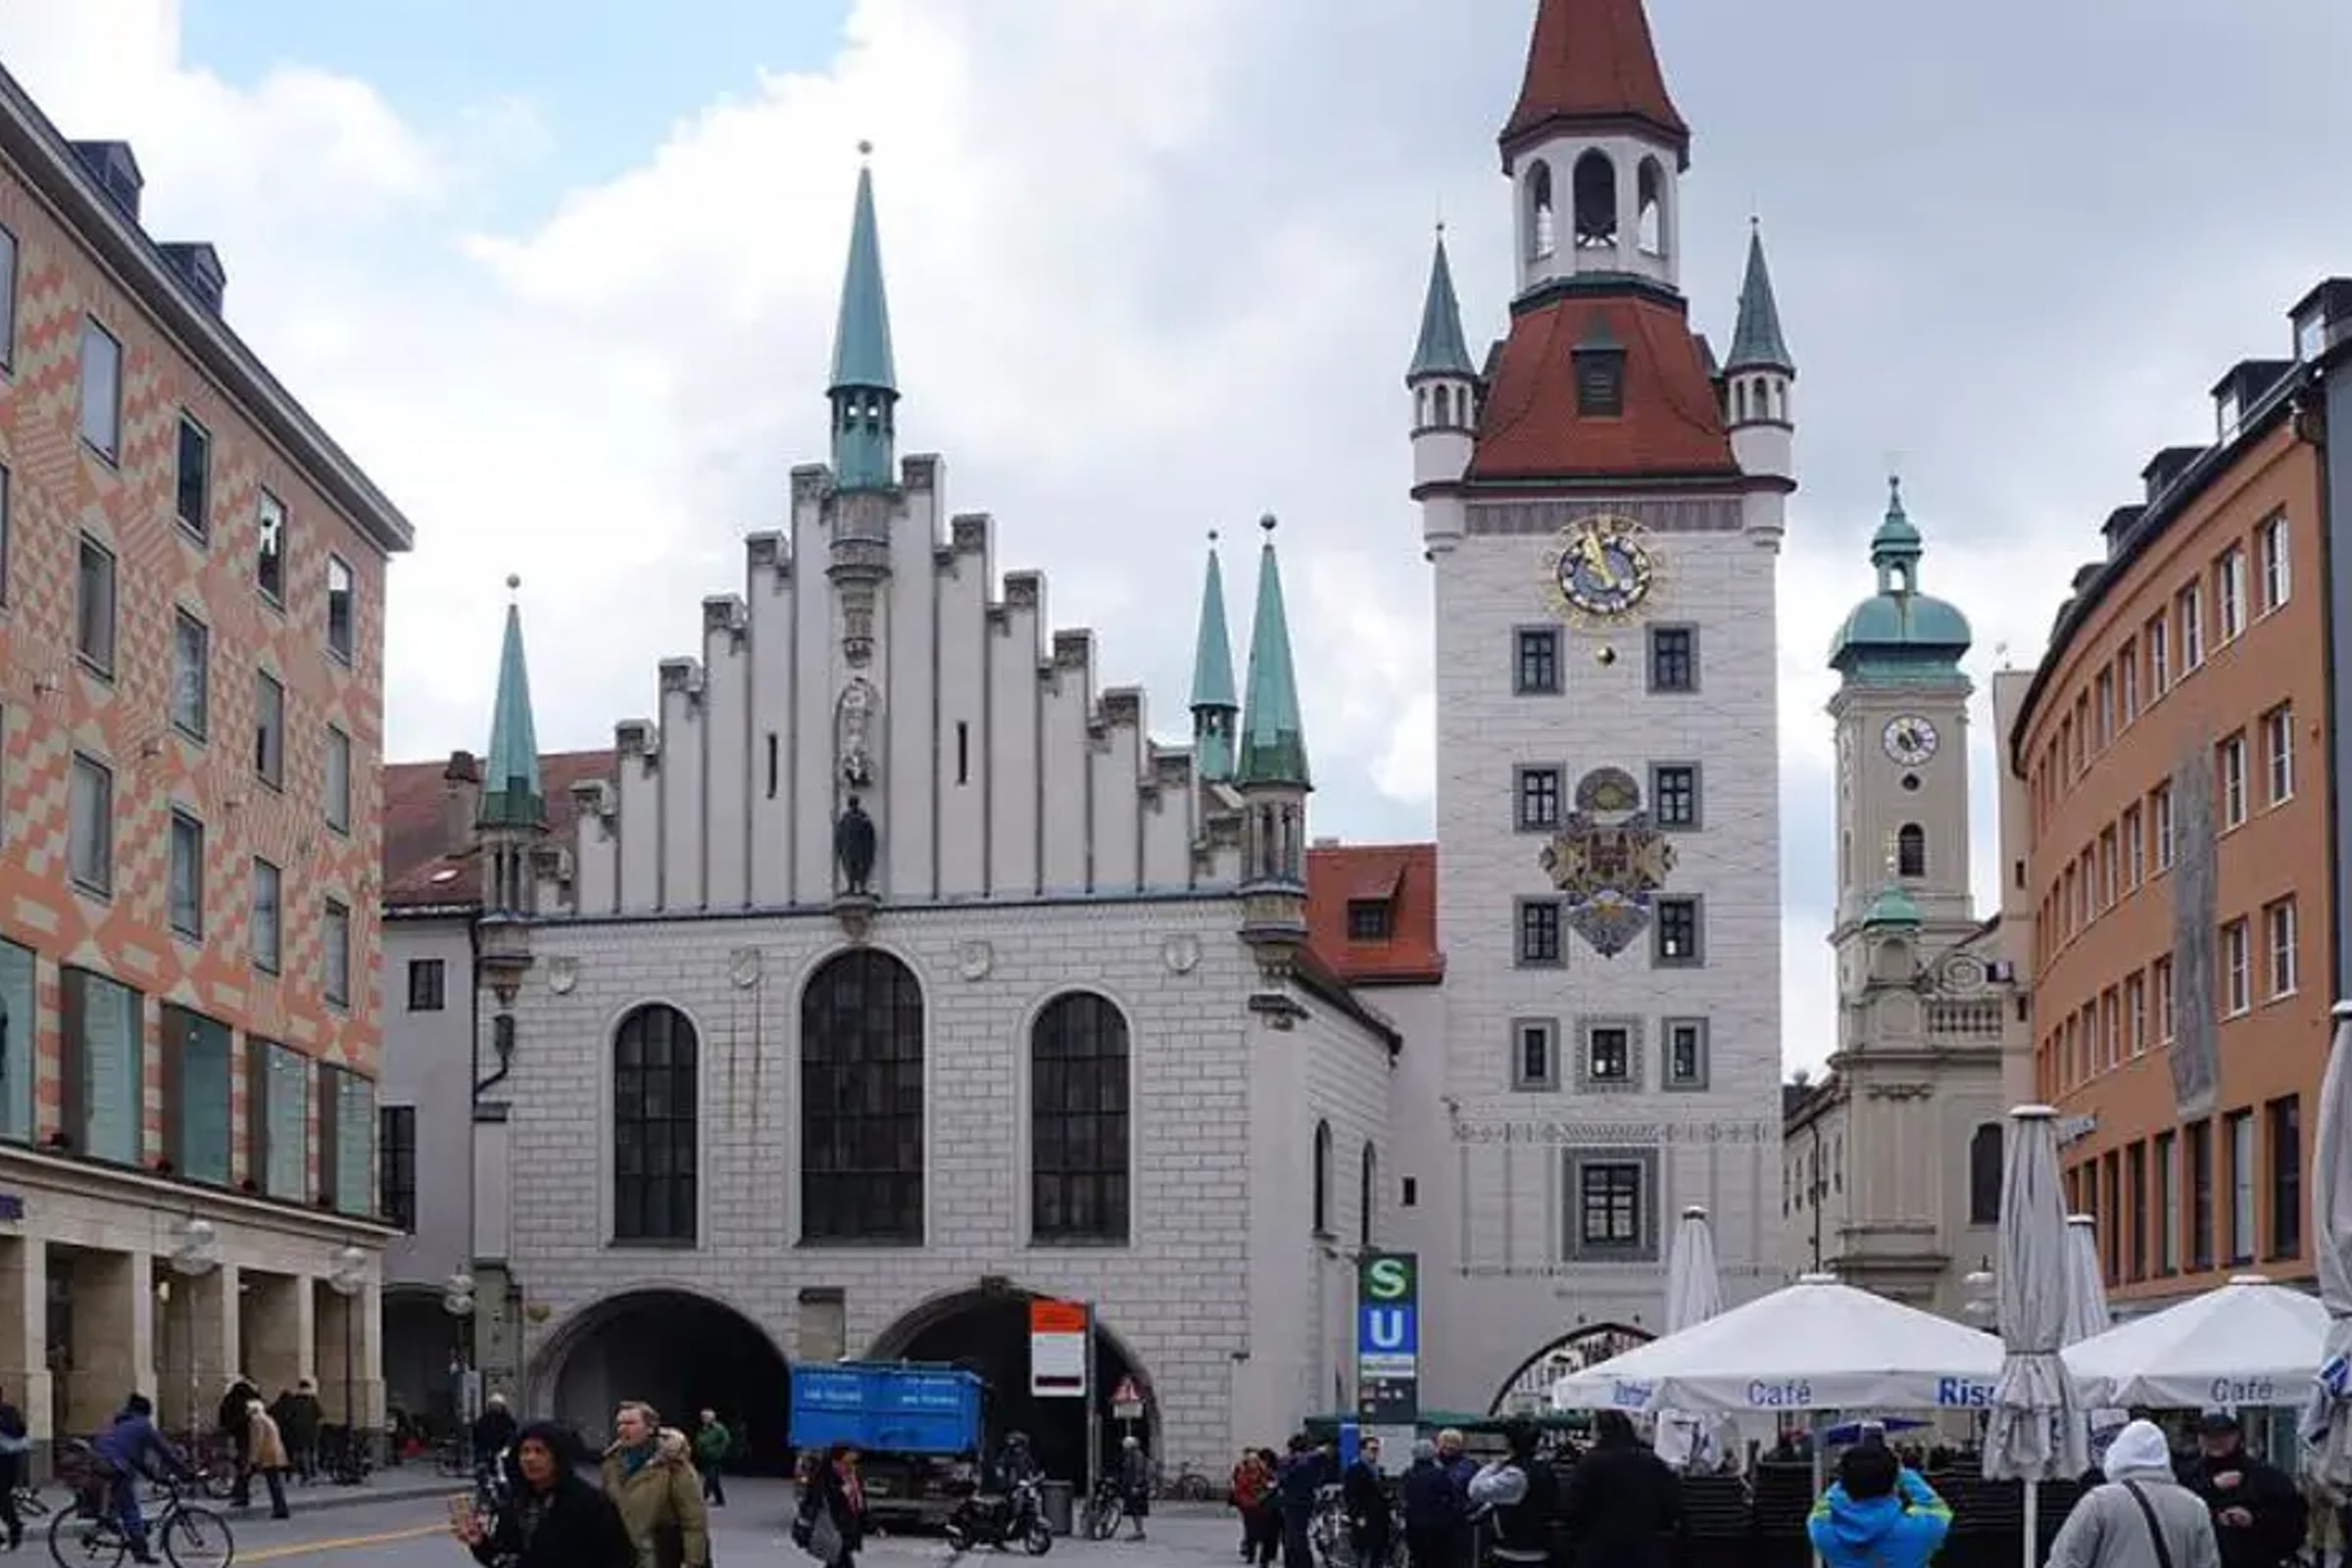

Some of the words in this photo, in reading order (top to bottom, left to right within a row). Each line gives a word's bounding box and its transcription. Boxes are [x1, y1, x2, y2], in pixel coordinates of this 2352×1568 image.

[1371, 1259, 1405, 1298] S
[1371, 1310, 1402, 1348] U
[1747, 1378, 1812, 1405] Café
[2211, 1376, 2273, 1402] Café
